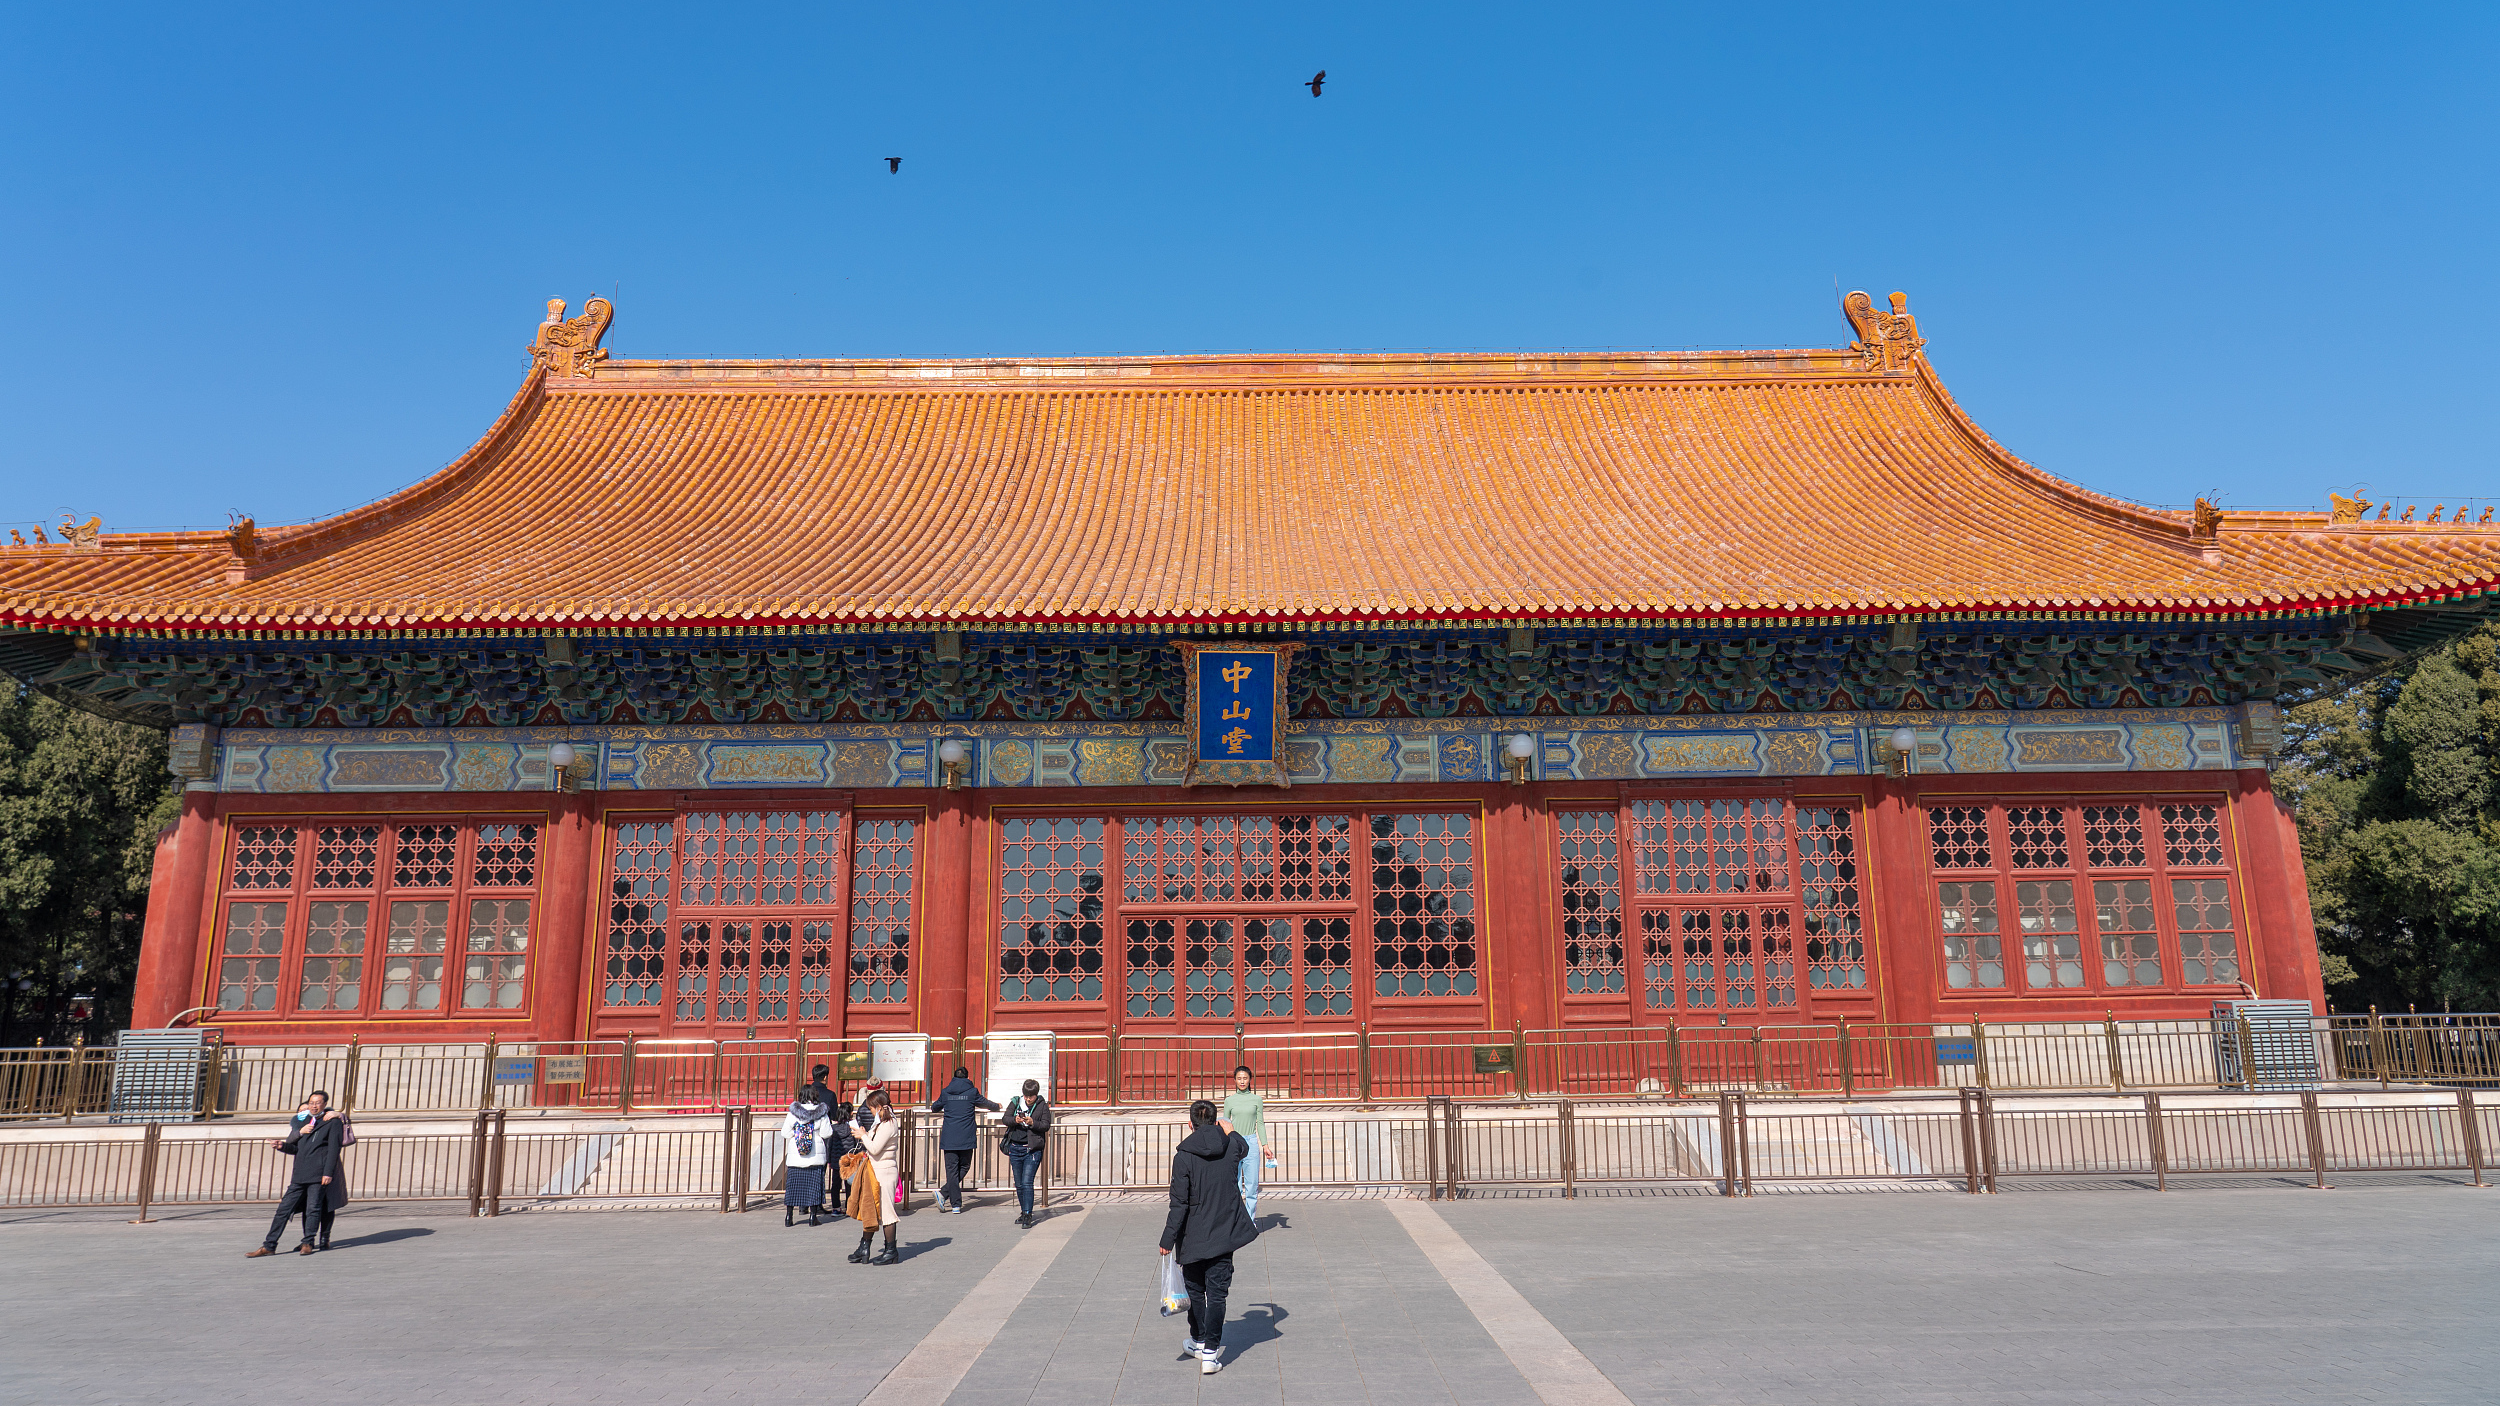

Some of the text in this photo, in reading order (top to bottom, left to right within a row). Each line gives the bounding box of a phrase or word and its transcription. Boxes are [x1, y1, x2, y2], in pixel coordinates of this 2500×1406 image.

[1221, 660, 1253, 754] 中山堂
[550, 1059, 581, 1068] 布展施工
[550, 1071, 581, 1079] 暂停开放
